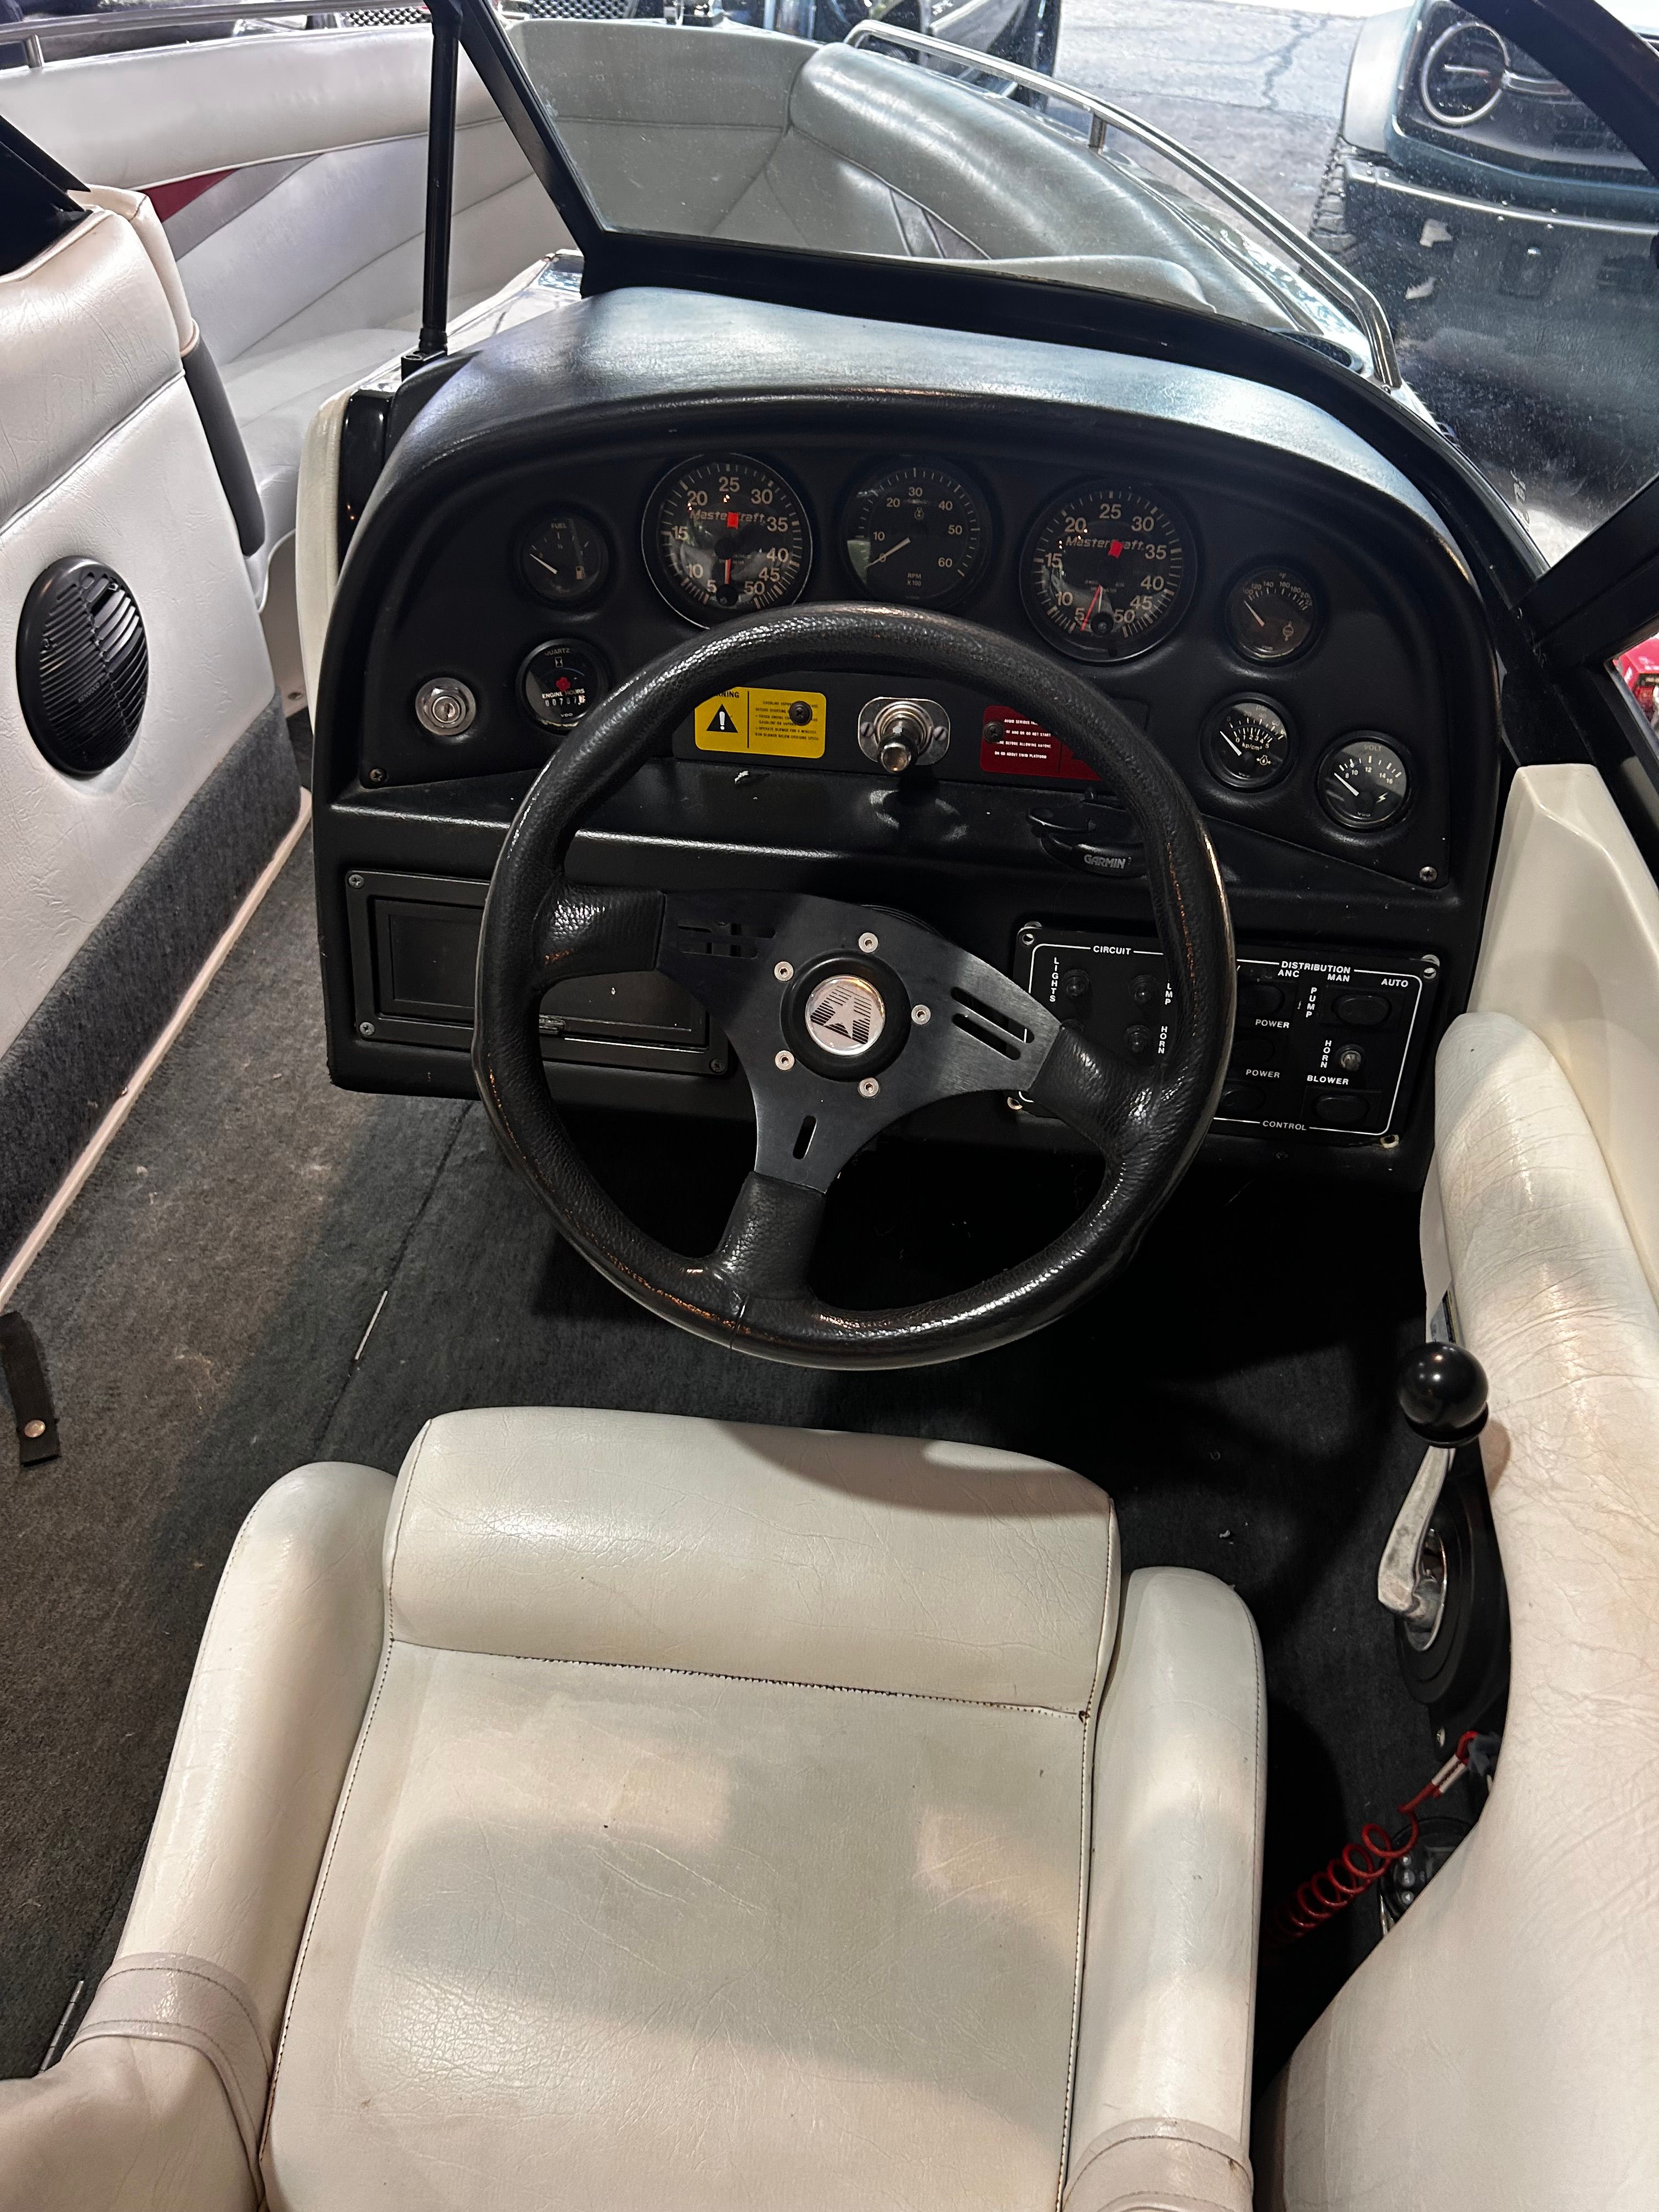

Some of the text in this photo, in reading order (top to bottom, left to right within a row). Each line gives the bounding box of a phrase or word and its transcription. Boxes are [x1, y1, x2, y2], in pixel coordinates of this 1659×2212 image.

[719, 477, 740, 492] 25
[909, 487, 923, 496] 30
[687, 490, 708, 506] 20
[751, 489, 772, 504] 30
[887, 498, 900, 508] 20
[939, 500, 953, 510] 40
[1099, 504, 1121, 519] 25
[690, 509, 765, 522] Masteraft
[767, 517, 788, 532] 35
[948, 524, 963, 535] 50
[1065, 517, 1086, 533] 20
[1131, 516, 1154, 532] 30
[672, 527, 689, 541] 15
[873, 531, 885, 541] 10
[1066, 536, 1143, 550] Masteraft
[766, 548, 789, 562] 40
[1145, 544, 1167, 560] 35
[938, 557, 952, 568] 60
[1045, 553, 1063, 568] 15
[687, 564, 703, 578] 10
[759, 567, 780, 582] 45
[707, 580, 717, 592] 5
[744, 582, 765, 595] 50
[1141, 575, 1164, 591] 40
[1056, 592, 1073, 606] 10
[1130, 596, 1152, 610] 45
[1074, 607, 1085, 621] 5
[1114, 609, 1135, 623] 50
[1084, 854, 1126, 869] GARMIN
[1093, 945, 1131, 955] CIRCUIT
[1278, 969, 1300, 978] ANC
[1281, 961, 1351, 974] DISTRIBUTION
[1049, 957, 1059, 1002] LIGHTS
[1327, 973, 1350, 982] MAN
[1381, 978, 1409, 988] AUTO
[1306, 987, 1317, 1018] PUMP
[1255, 1019, 1290, 1029] POWER
[1158, 1026, 1168, 1054] HORN
[1320, 1040, 1332, 1068] HORN
[1245, 1069, 1280, 1079] POWER
[1307, 1075, 1349, 1085] BLOWER
[1262, 1120, 1307, 1131] CONTROL
